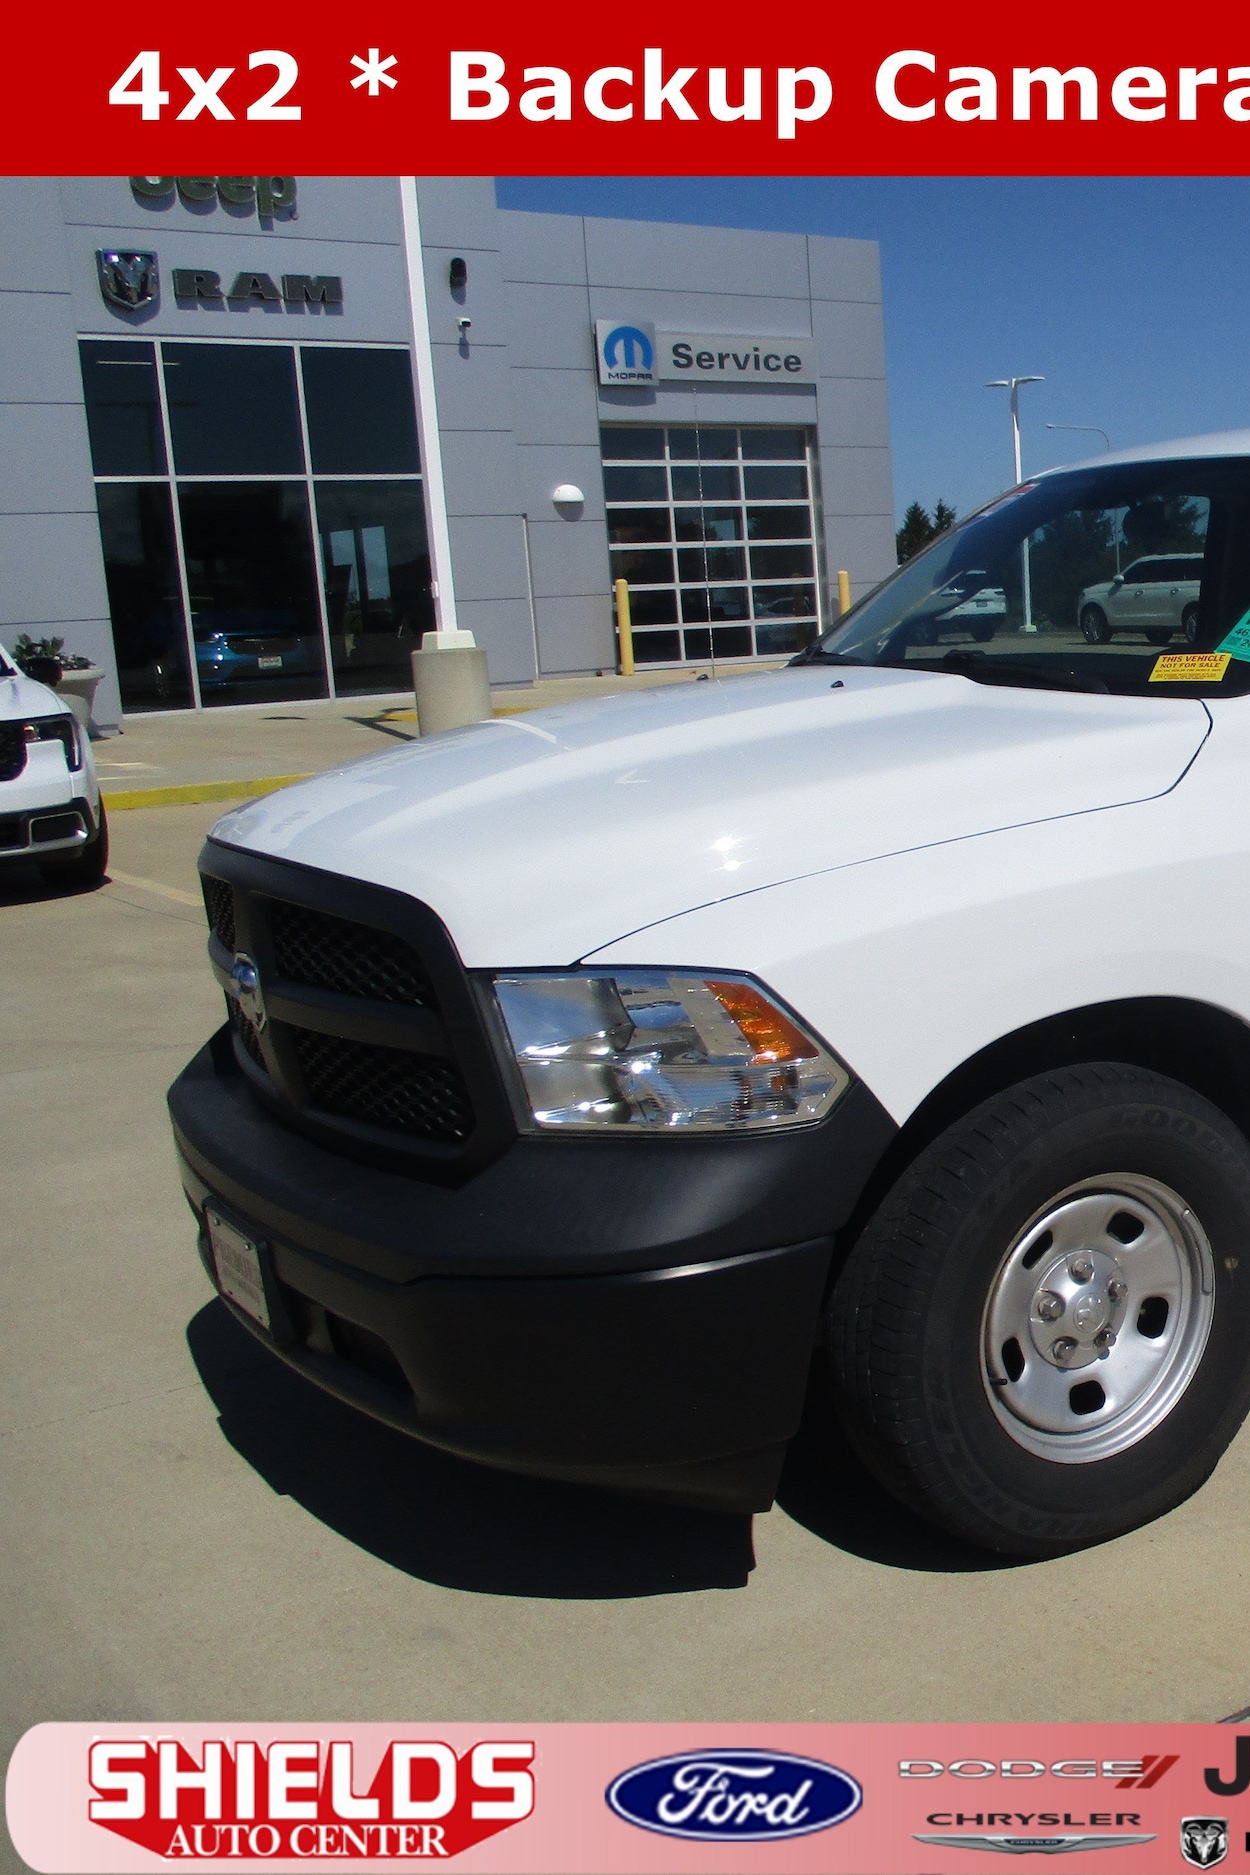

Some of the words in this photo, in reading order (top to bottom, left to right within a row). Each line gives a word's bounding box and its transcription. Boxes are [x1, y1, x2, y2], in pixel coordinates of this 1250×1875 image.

[172, 268, 343, 302] RAM
[672, 342, 802, 372] Service
[607, 372, 653, 380] MOPAR
[1161, 655, 1183, 663] THIS
[1185, 654, 1226, 662] VEHICLE
